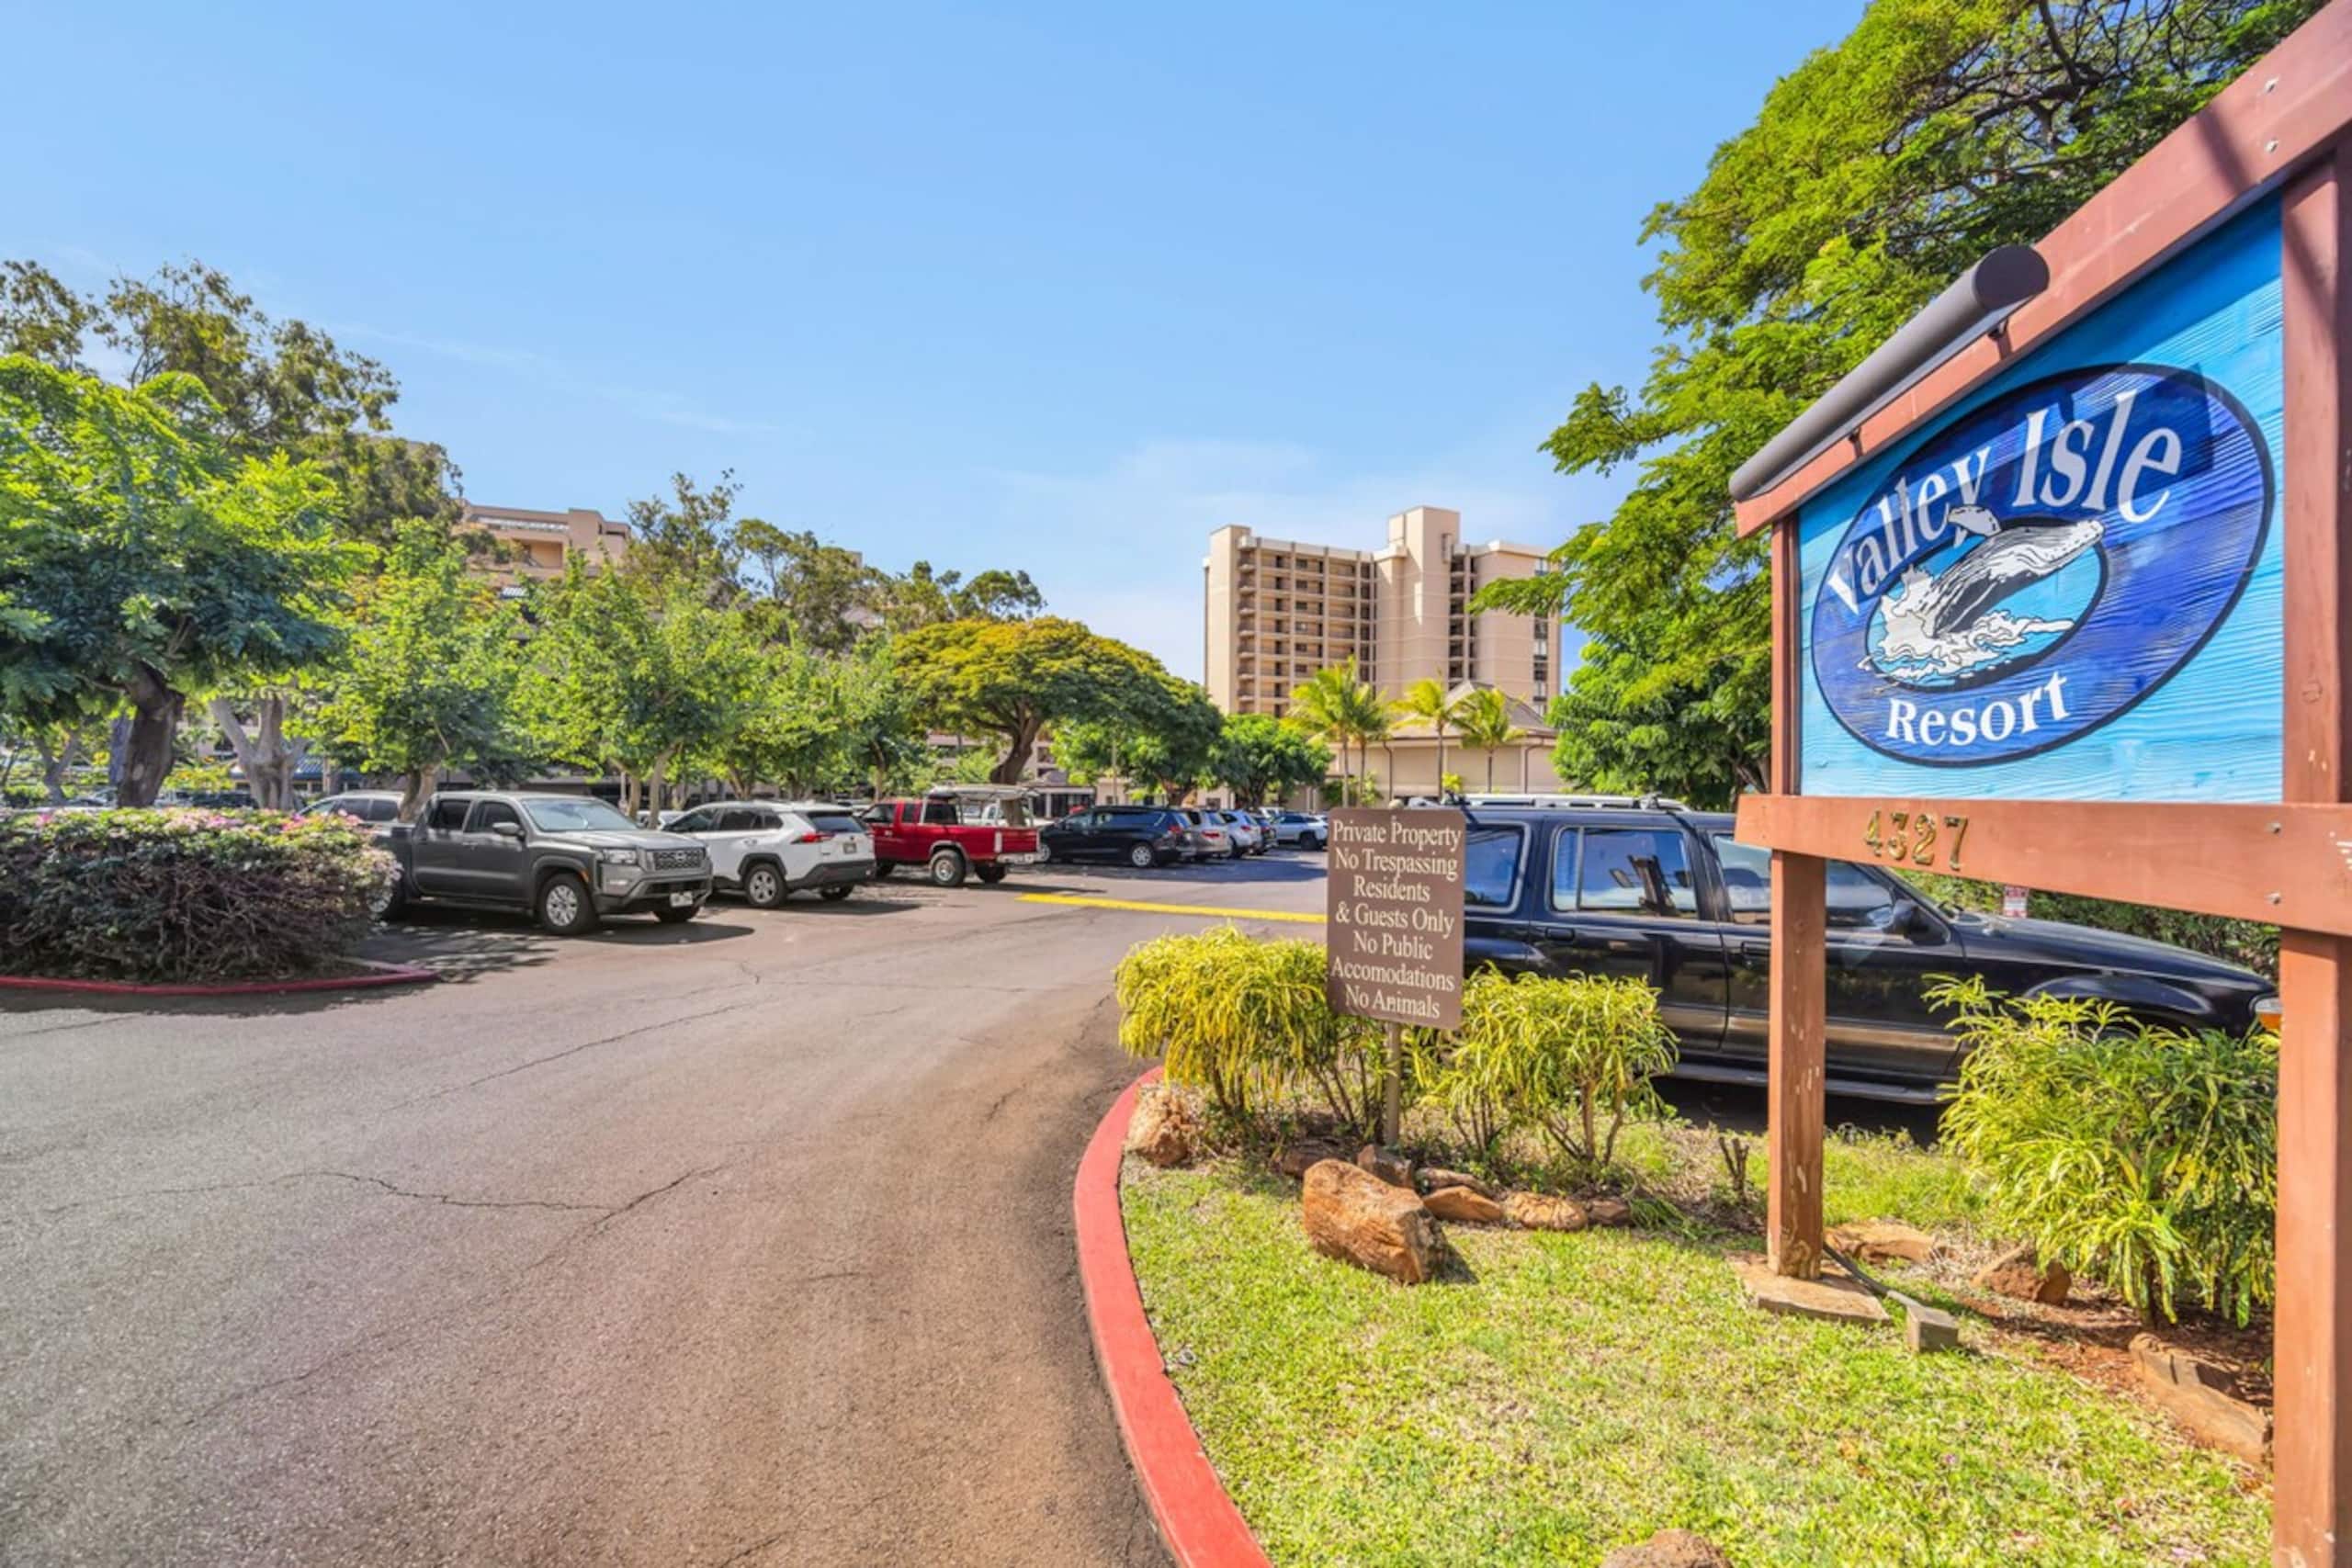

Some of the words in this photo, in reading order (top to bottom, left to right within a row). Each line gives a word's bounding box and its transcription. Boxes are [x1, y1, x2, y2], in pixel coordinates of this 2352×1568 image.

[1827, 446, 1991, 616] Valley
[2013, 389, 2182, 524] Isle
[1886, 671, 2073, 746] Resort
[1333, 819, 1386, 844] Private
[1390, 820, 1462, 852] Property
[1864, 810, 1969, 871] 4327
[1335, 847, 1359, 869] No
[1362, 848, 1458, 882] Trespassing
[1353, 875, 1430, 902] Residents
[1336, 901, 1351, 923] &
[1354, 902, 1408, 927] Guests
[1412, 907, 1454, 939] Only
[1353, 931, 1377, 954] No
[1382, 933, 1433, 960] Public
[1330, 955, 1454, 992] Accomodations
[1345, 984, 1369, 1009] No
[1373, 989, 1441, 1019] Animals
